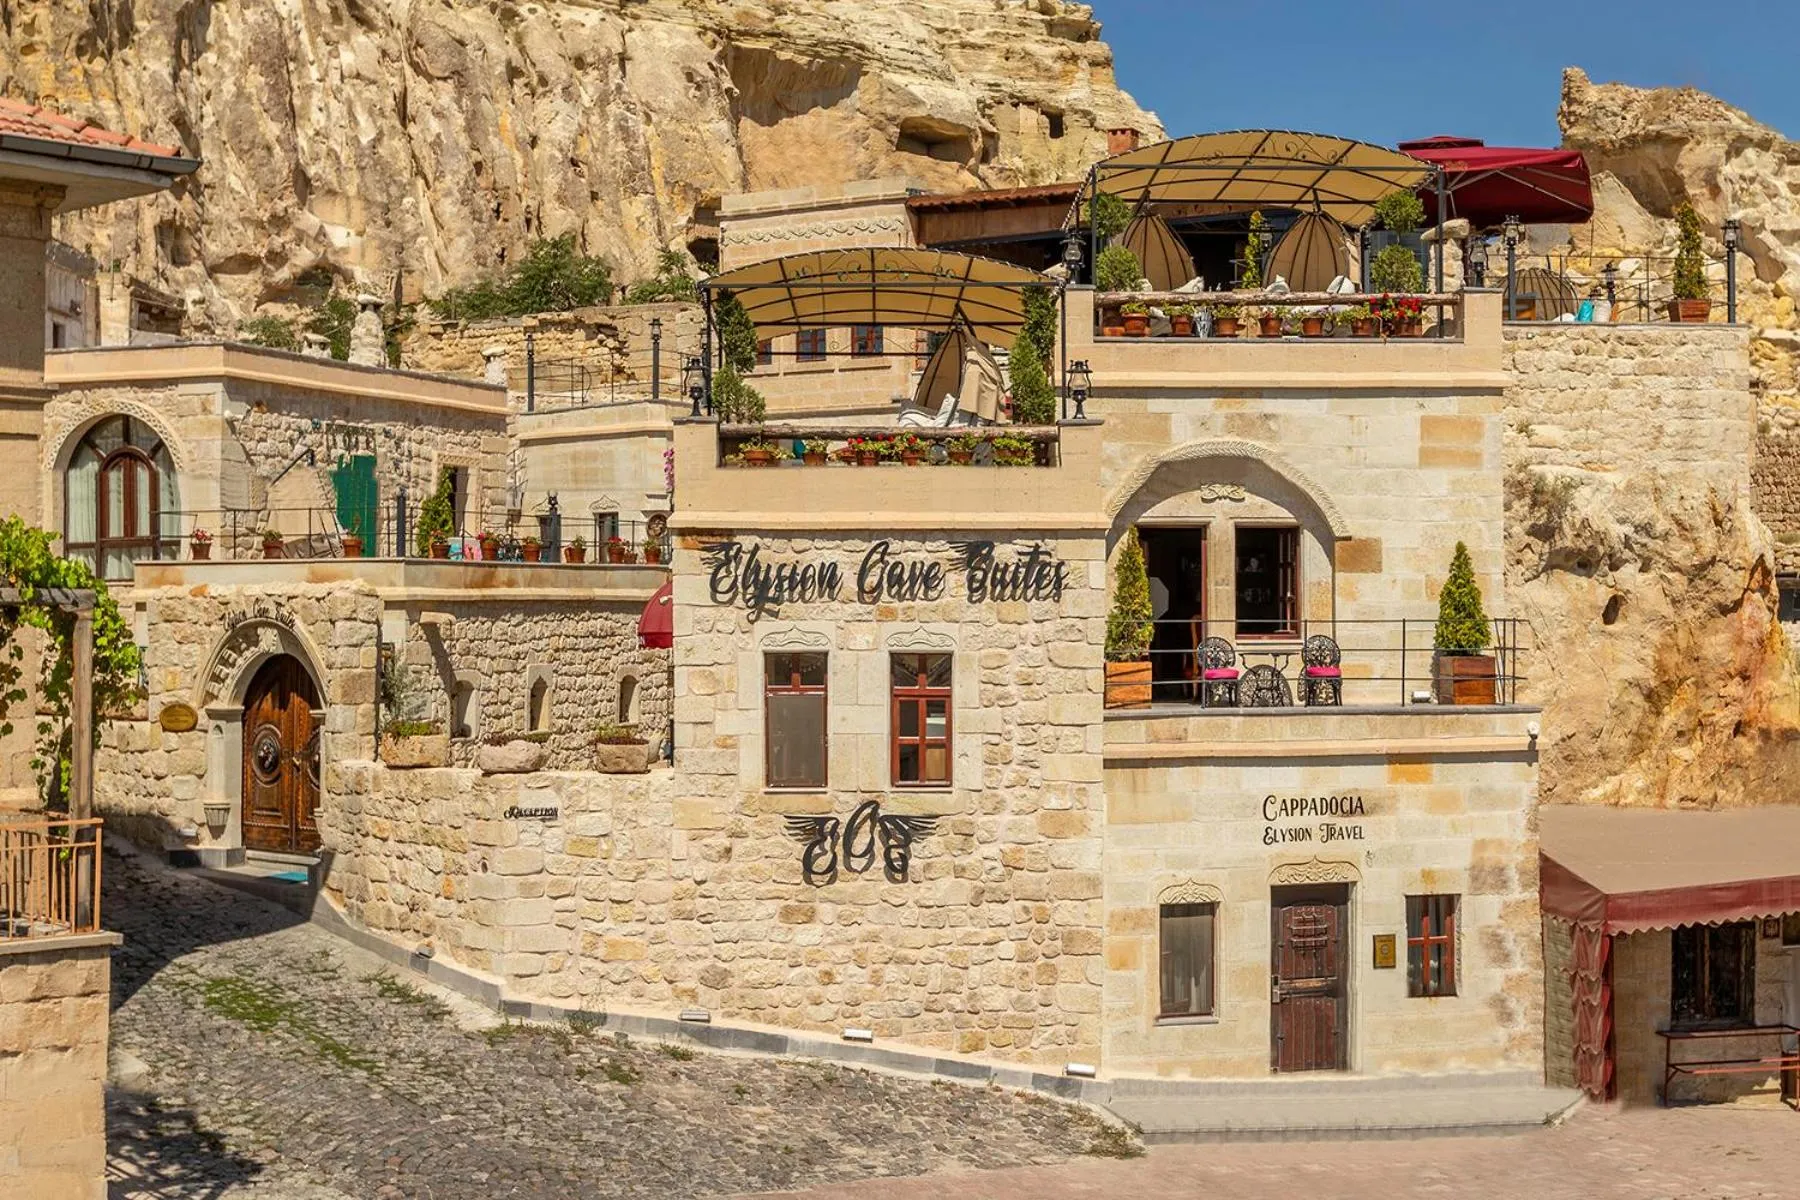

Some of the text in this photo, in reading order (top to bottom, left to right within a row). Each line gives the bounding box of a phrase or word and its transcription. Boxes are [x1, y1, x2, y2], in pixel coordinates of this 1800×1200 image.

[703, 541, 1069, 623] Elysion Cave Suites
[1263, 795, 1365, 821] CAPPADOCIA
[1263, 823, 1365, 845] ELYSION TRAVEL
